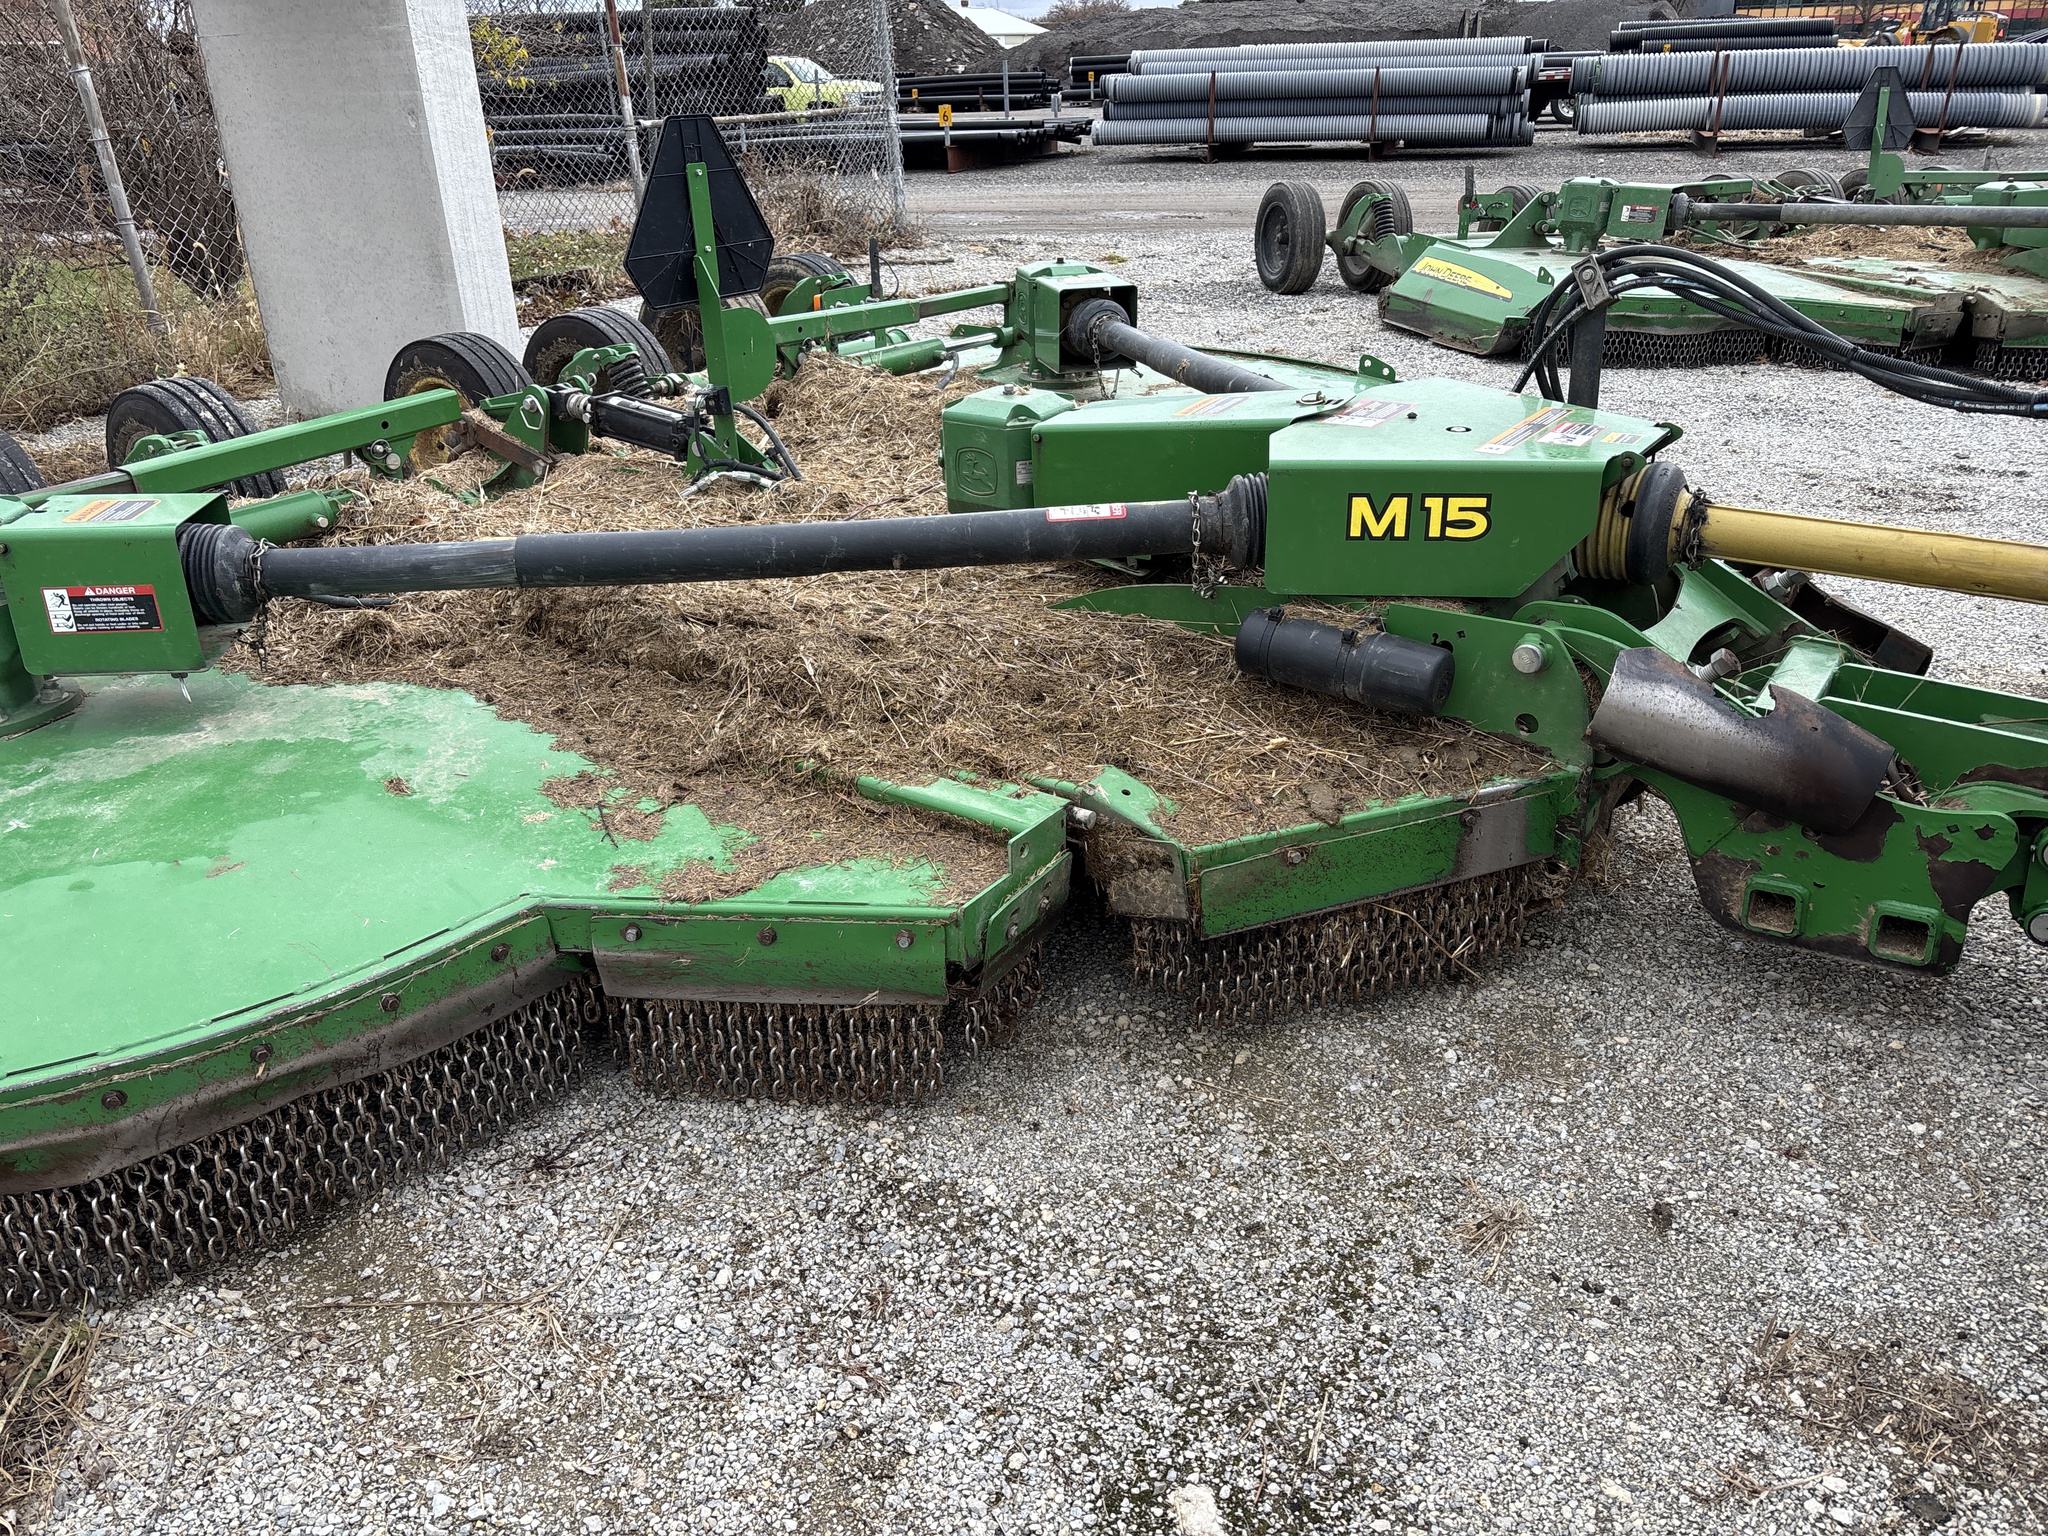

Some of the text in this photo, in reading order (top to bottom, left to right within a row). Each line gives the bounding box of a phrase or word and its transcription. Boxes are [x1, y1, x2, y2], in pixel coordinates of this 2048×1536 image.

[942, 110, 950, 122] 6
[1419, 262, 1472, 284] JOHN DEERE
[1347, 494, 1492, 541] M 15
[95, 586, 136, 595] DANGER
